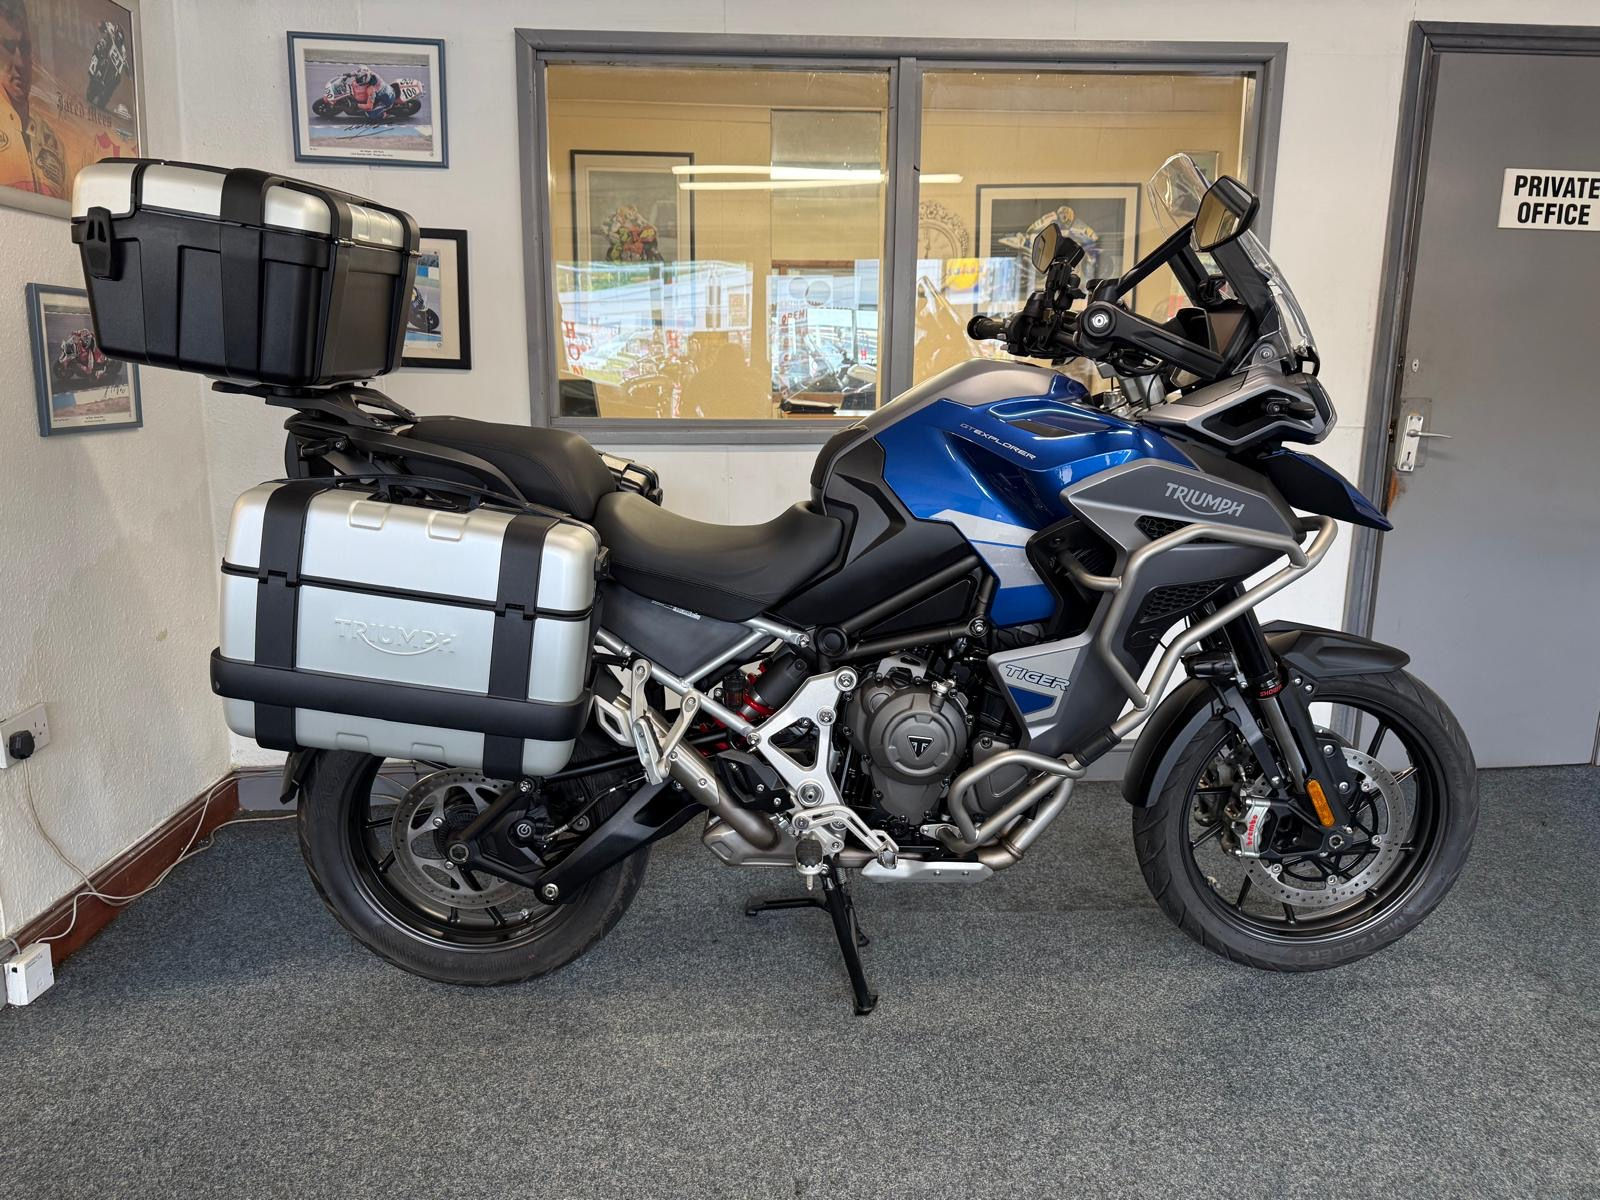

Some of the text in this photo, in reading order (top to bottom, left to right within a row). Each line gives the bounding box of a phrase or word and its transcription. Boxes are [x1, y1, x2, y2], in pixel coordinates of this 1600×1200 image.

[1513, 175, 1600, 199] PRIVATE
[1517, 202, 1591, 225] OFFICE
[1164, 482, 1246, 517] TRIUMPH
[334, 617, 457, 655] TRIUMPH
[1005, 663, 1071, 692] TIGER
[1246, 814, 1259, 847] brembo
